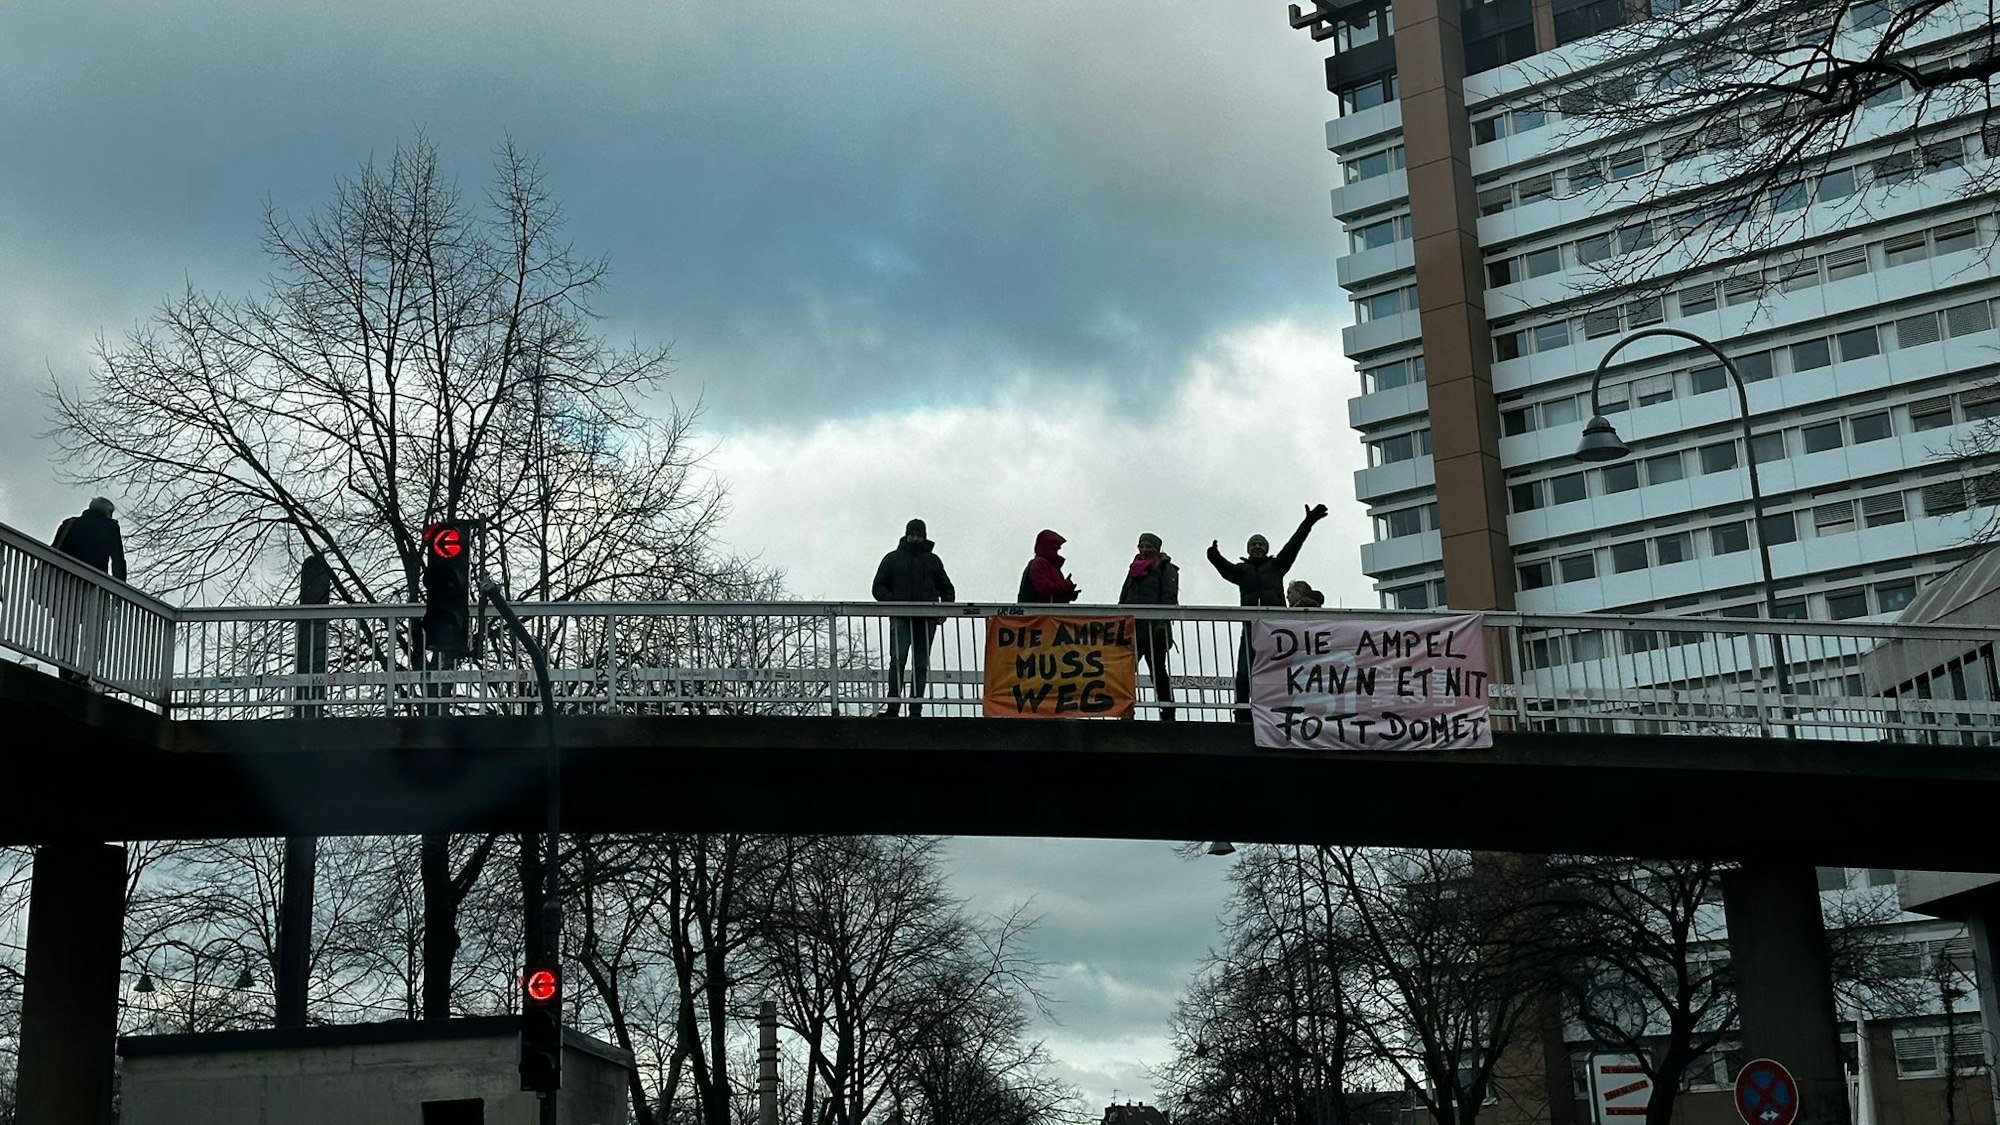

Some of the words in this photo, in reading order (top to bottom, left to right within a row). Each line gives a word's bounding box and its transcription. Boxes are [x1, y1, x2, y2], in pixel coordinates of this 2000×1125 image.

[998, 626, 1042, 648] DIE
[1052, 619, 1132, 647] AMPEL
[1270, 628, 1331, 660] DIE
[1355, 630, 1467, 660] AMPEL
[1016, 650, 1104, 680] MUSS
[1012, 680, 1115, 714] WEG
[1286, 664, 1377, 696] KANN
[1397, 665, 1433, 698] ET
[1445, 666, 1488, 699] NIT
